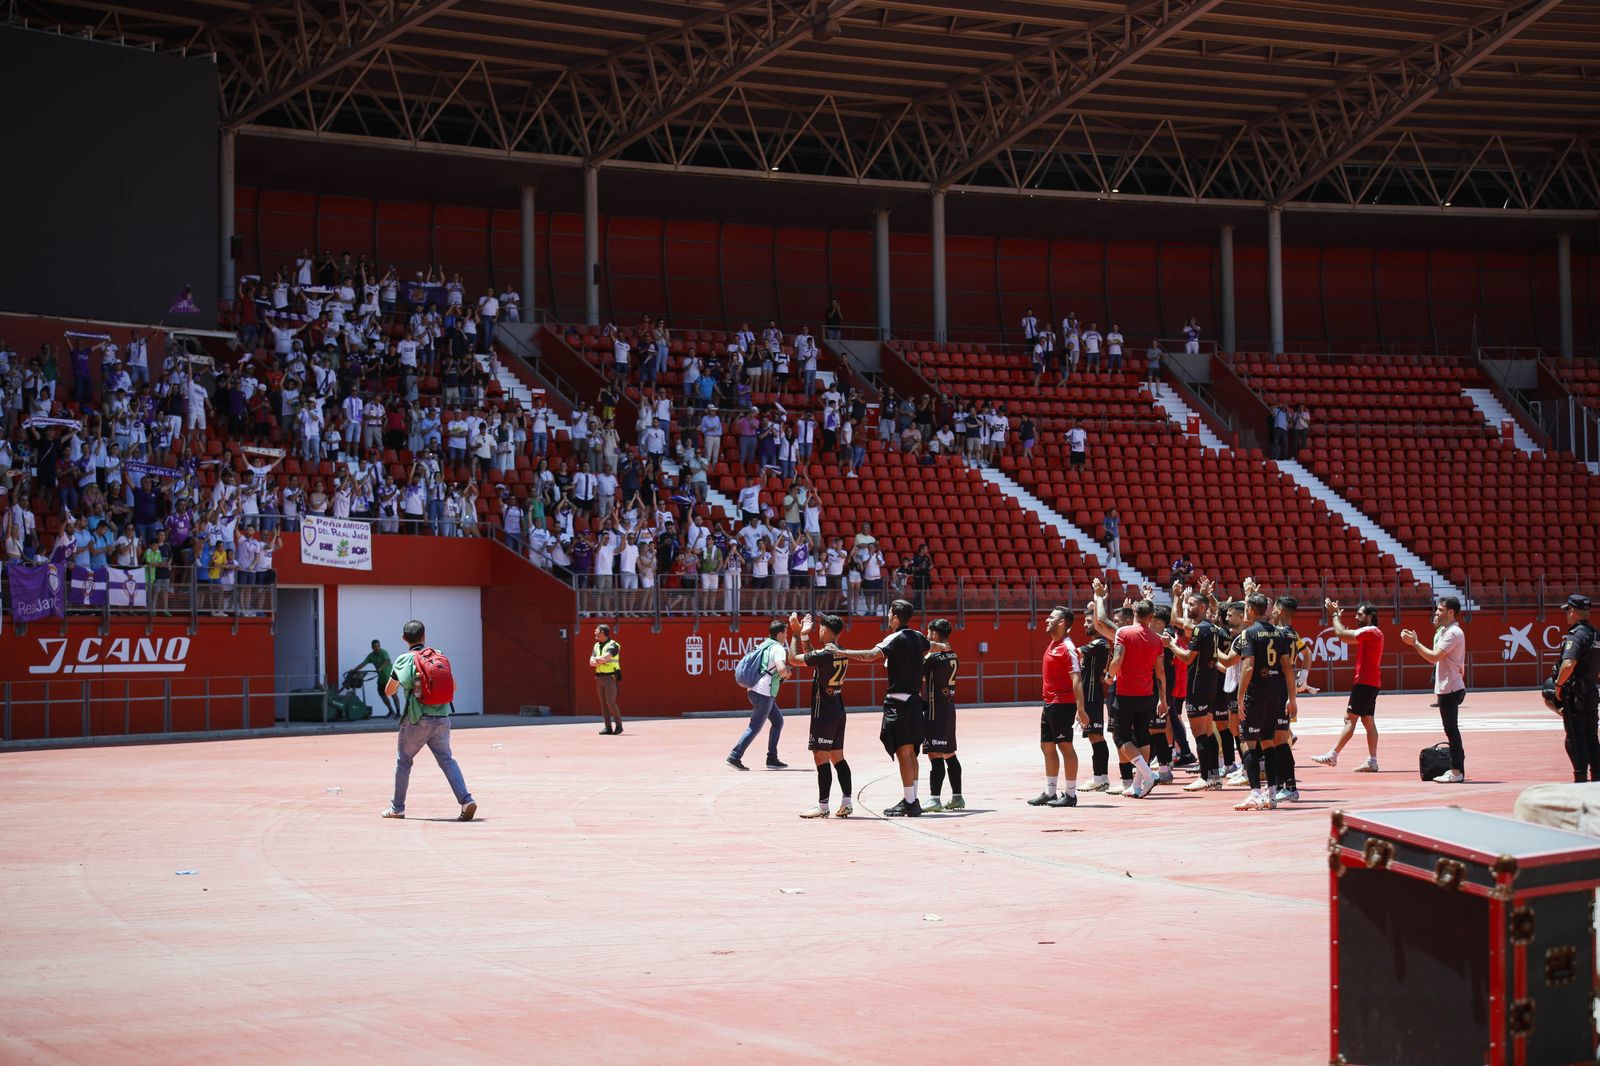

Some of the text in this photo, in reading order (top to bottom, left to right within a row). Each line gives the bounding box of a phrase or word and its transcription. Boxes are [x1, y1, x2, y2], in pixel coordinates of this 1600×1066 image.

[342, 522, 369, 530] AMIGOS
[1267, 639, 1277, 666] 6
[718, 659, 739, 671] CIUD
